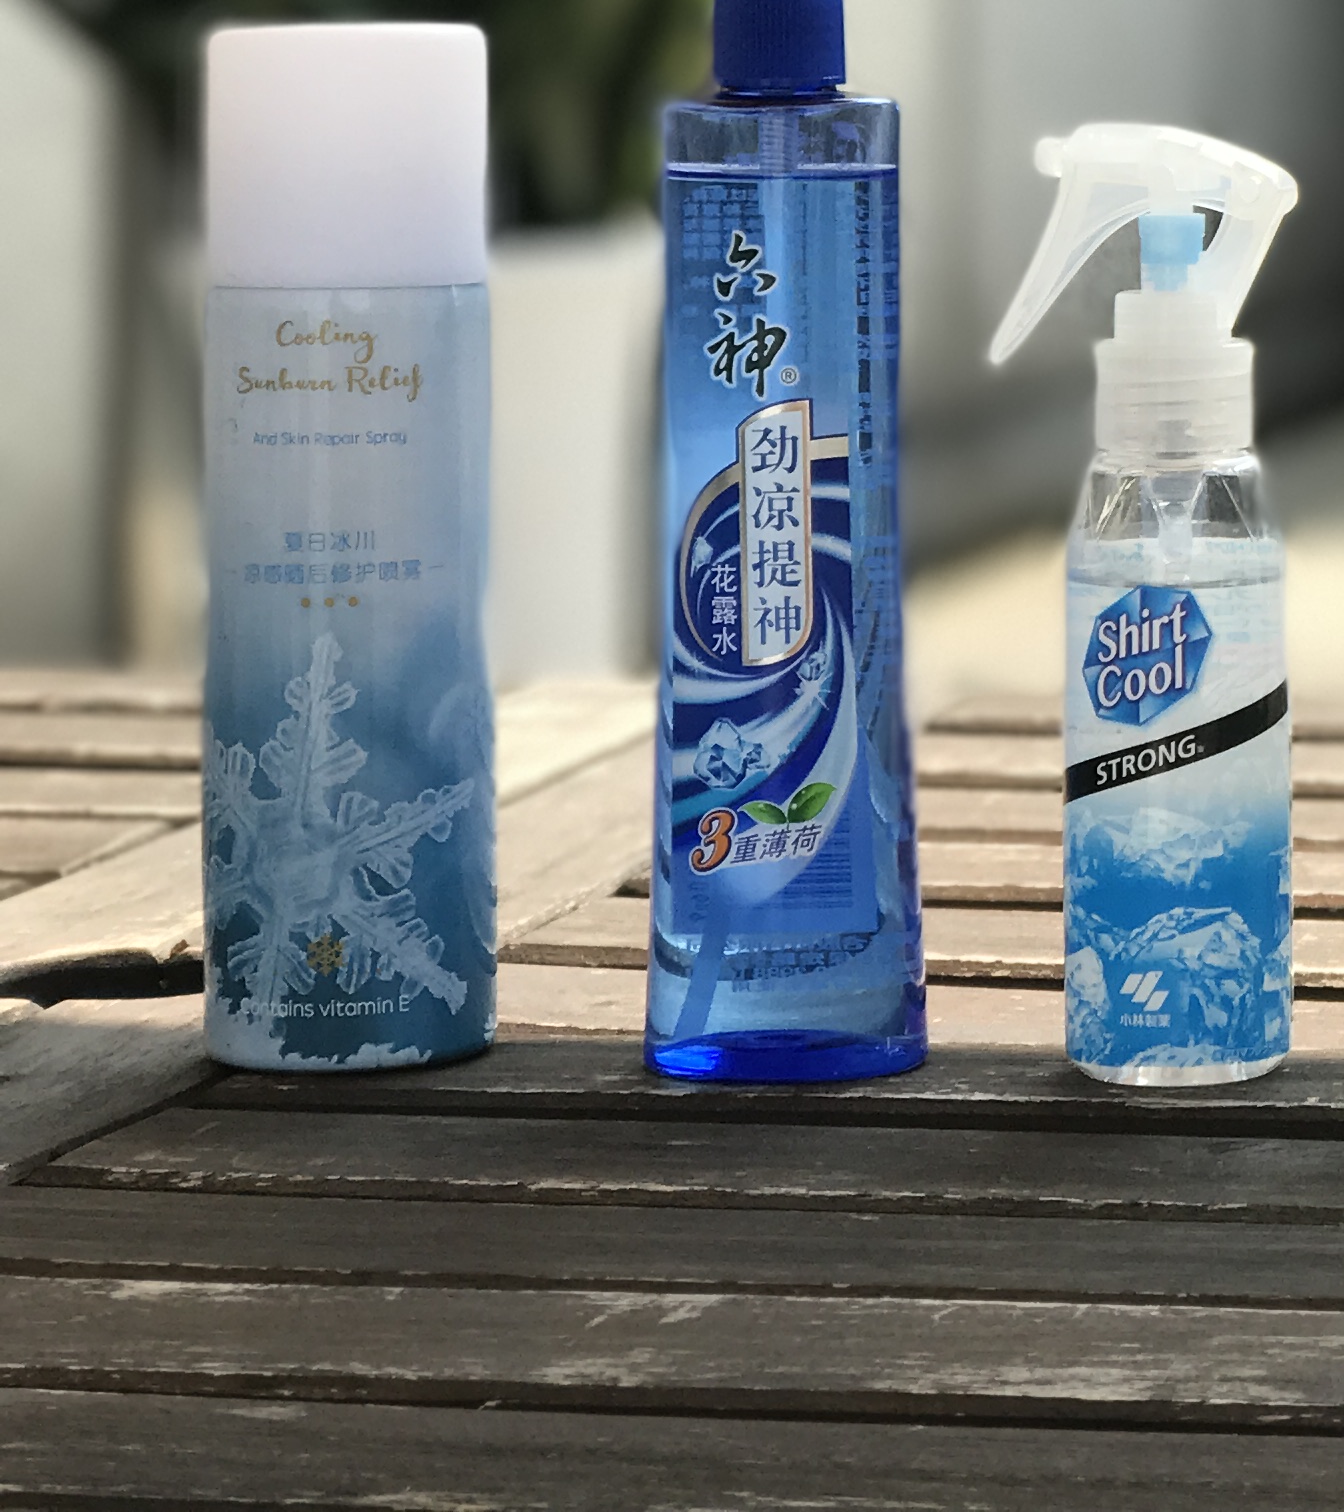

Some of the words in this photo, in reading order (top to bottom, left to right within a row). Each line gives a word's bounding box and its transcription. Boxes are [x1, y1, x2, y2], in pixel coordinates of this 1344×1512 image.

[276, 320, 378, 364] Cooling
[706, 232, 787, 397] 六神
[237, 366, 335, 394] Sunburn
[344, 363, 423, 402] Relief
[253, 431, 278, 445] And
[281, 432, 310, 445] Skin
[313, 432, 360, 446] Repair
[366, 430, 408, 445] Spray
[750, 423, 803, 647] 劲凉提神
[711, 563, 738, 656] 花露水
[1097, 602, 1187, 663] Shirt
[1097, 643, 1184, 707] Cool
[1096, 734, 1197, 786] STRONG
[690, 809, 823, 873] 3重薄荷
[319, 996, 394, 1017] vitamin
[398, 994, 411, 1012] E
